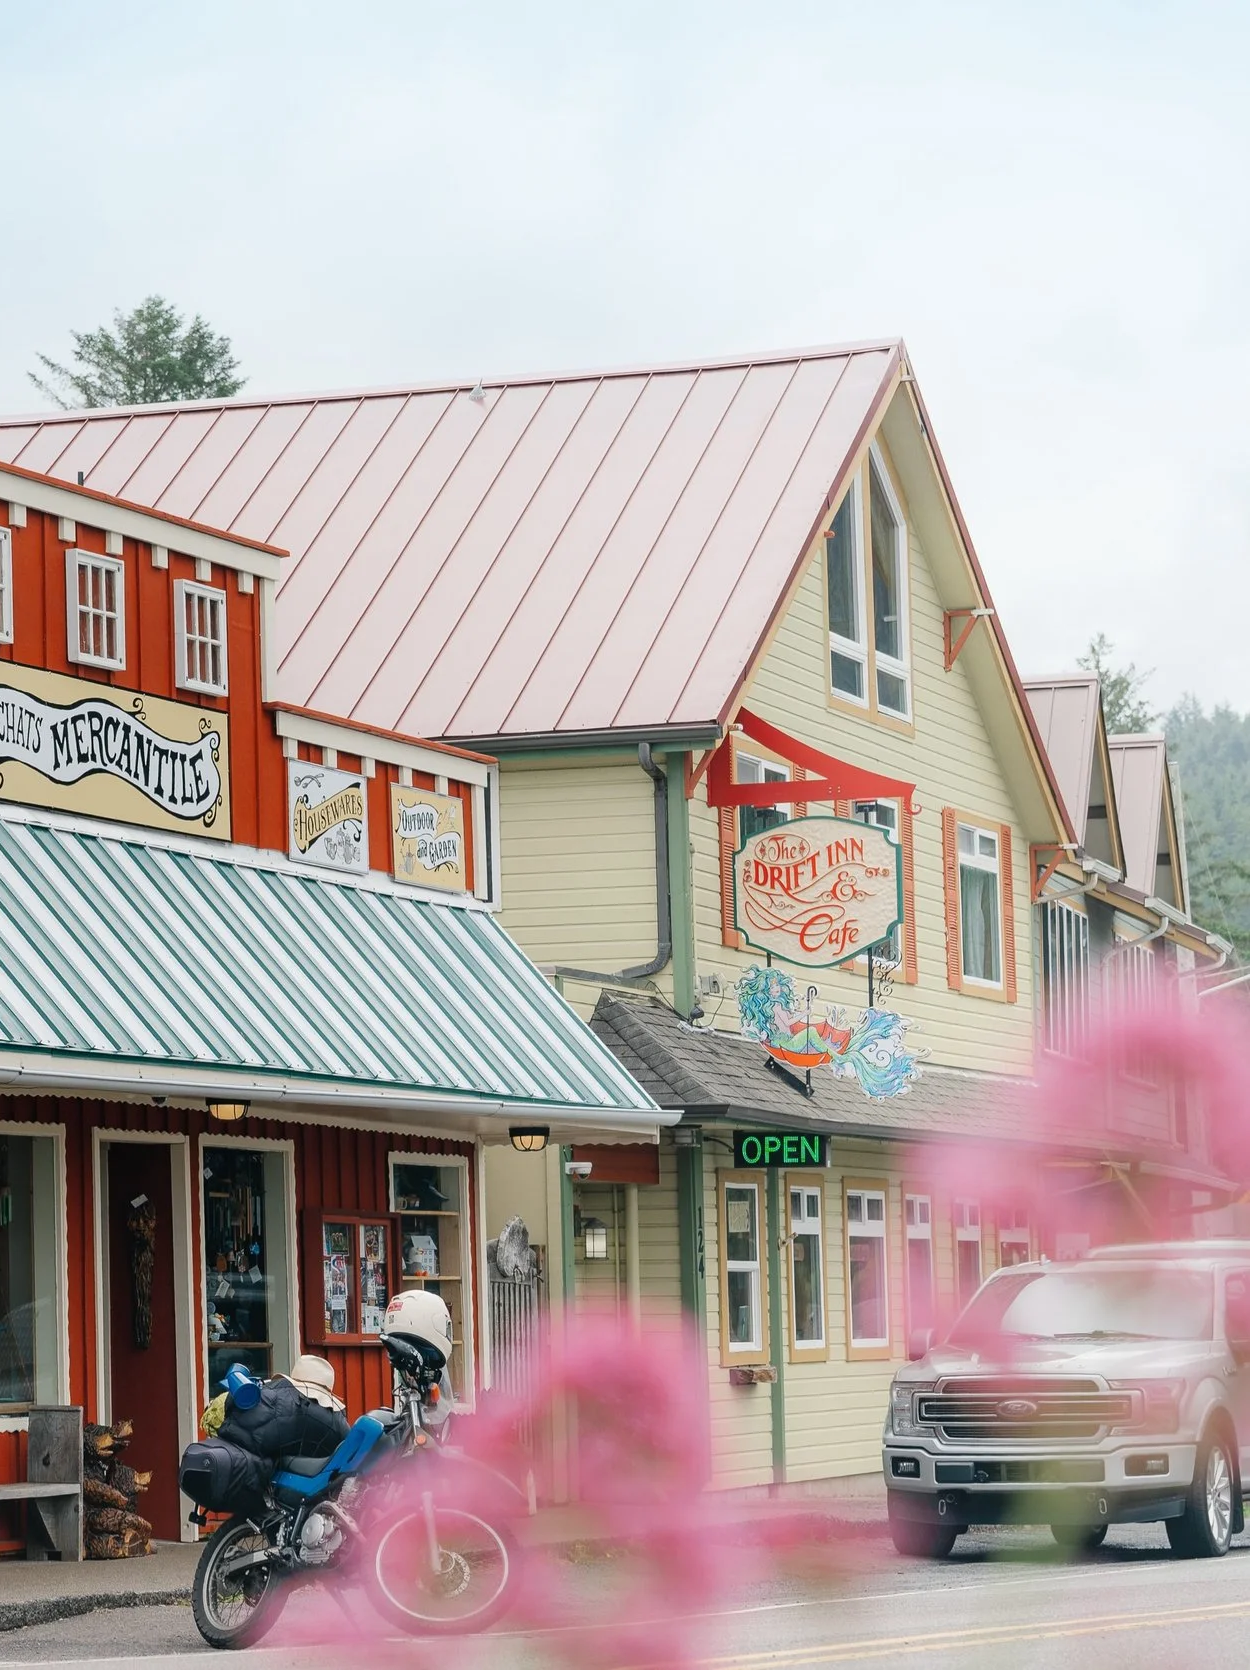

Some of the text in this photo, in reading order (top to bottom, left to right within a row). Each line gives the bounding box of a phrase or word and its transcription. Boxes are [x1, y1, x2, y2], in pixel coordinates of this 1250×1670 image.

[50, 711, 210, 805] MERCANTILE
[297, 794, 363, 841] HOUSEWARES
[402, 809, 435, 832] OUTDOOR
[417, 840, 457, 865] and GARDEN
[768, 836, 796, 862] The
[754, 837, 864, 898] DRIFT INN
[832, 871, 857, 902] &
[800, 913, 859, 956] Cafe
[742, 1135, 819, 1164] OPEN
